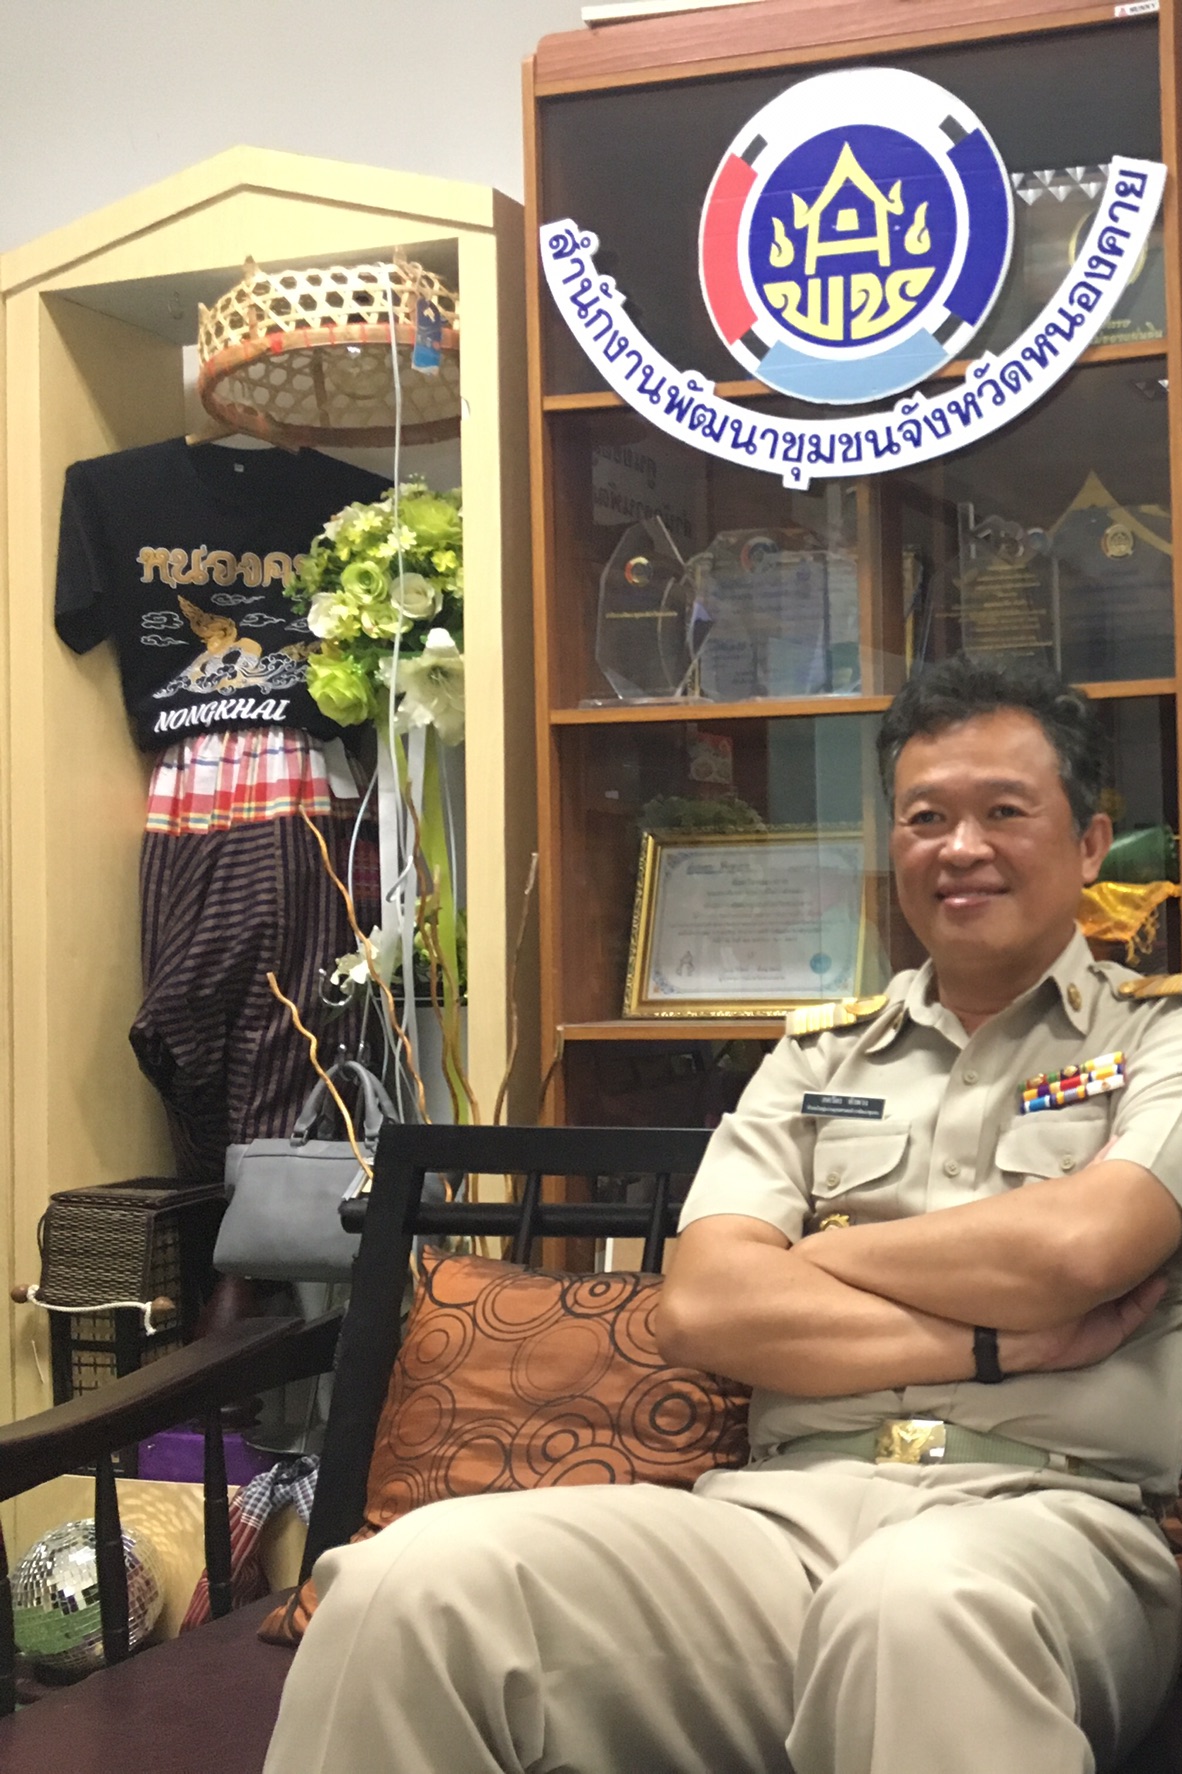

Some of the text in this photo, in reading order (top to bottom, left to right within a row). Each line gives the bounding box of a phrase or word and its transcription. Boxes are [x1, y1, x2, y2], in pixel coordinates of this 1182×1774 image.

[547, 168, 1148, 480] สำนักงานพัฒนาชุมชนจังหวัดหนองคาย
[136, 545, 308, 588] หนองค
[154, 698, 290, 733] NONGKHAI
